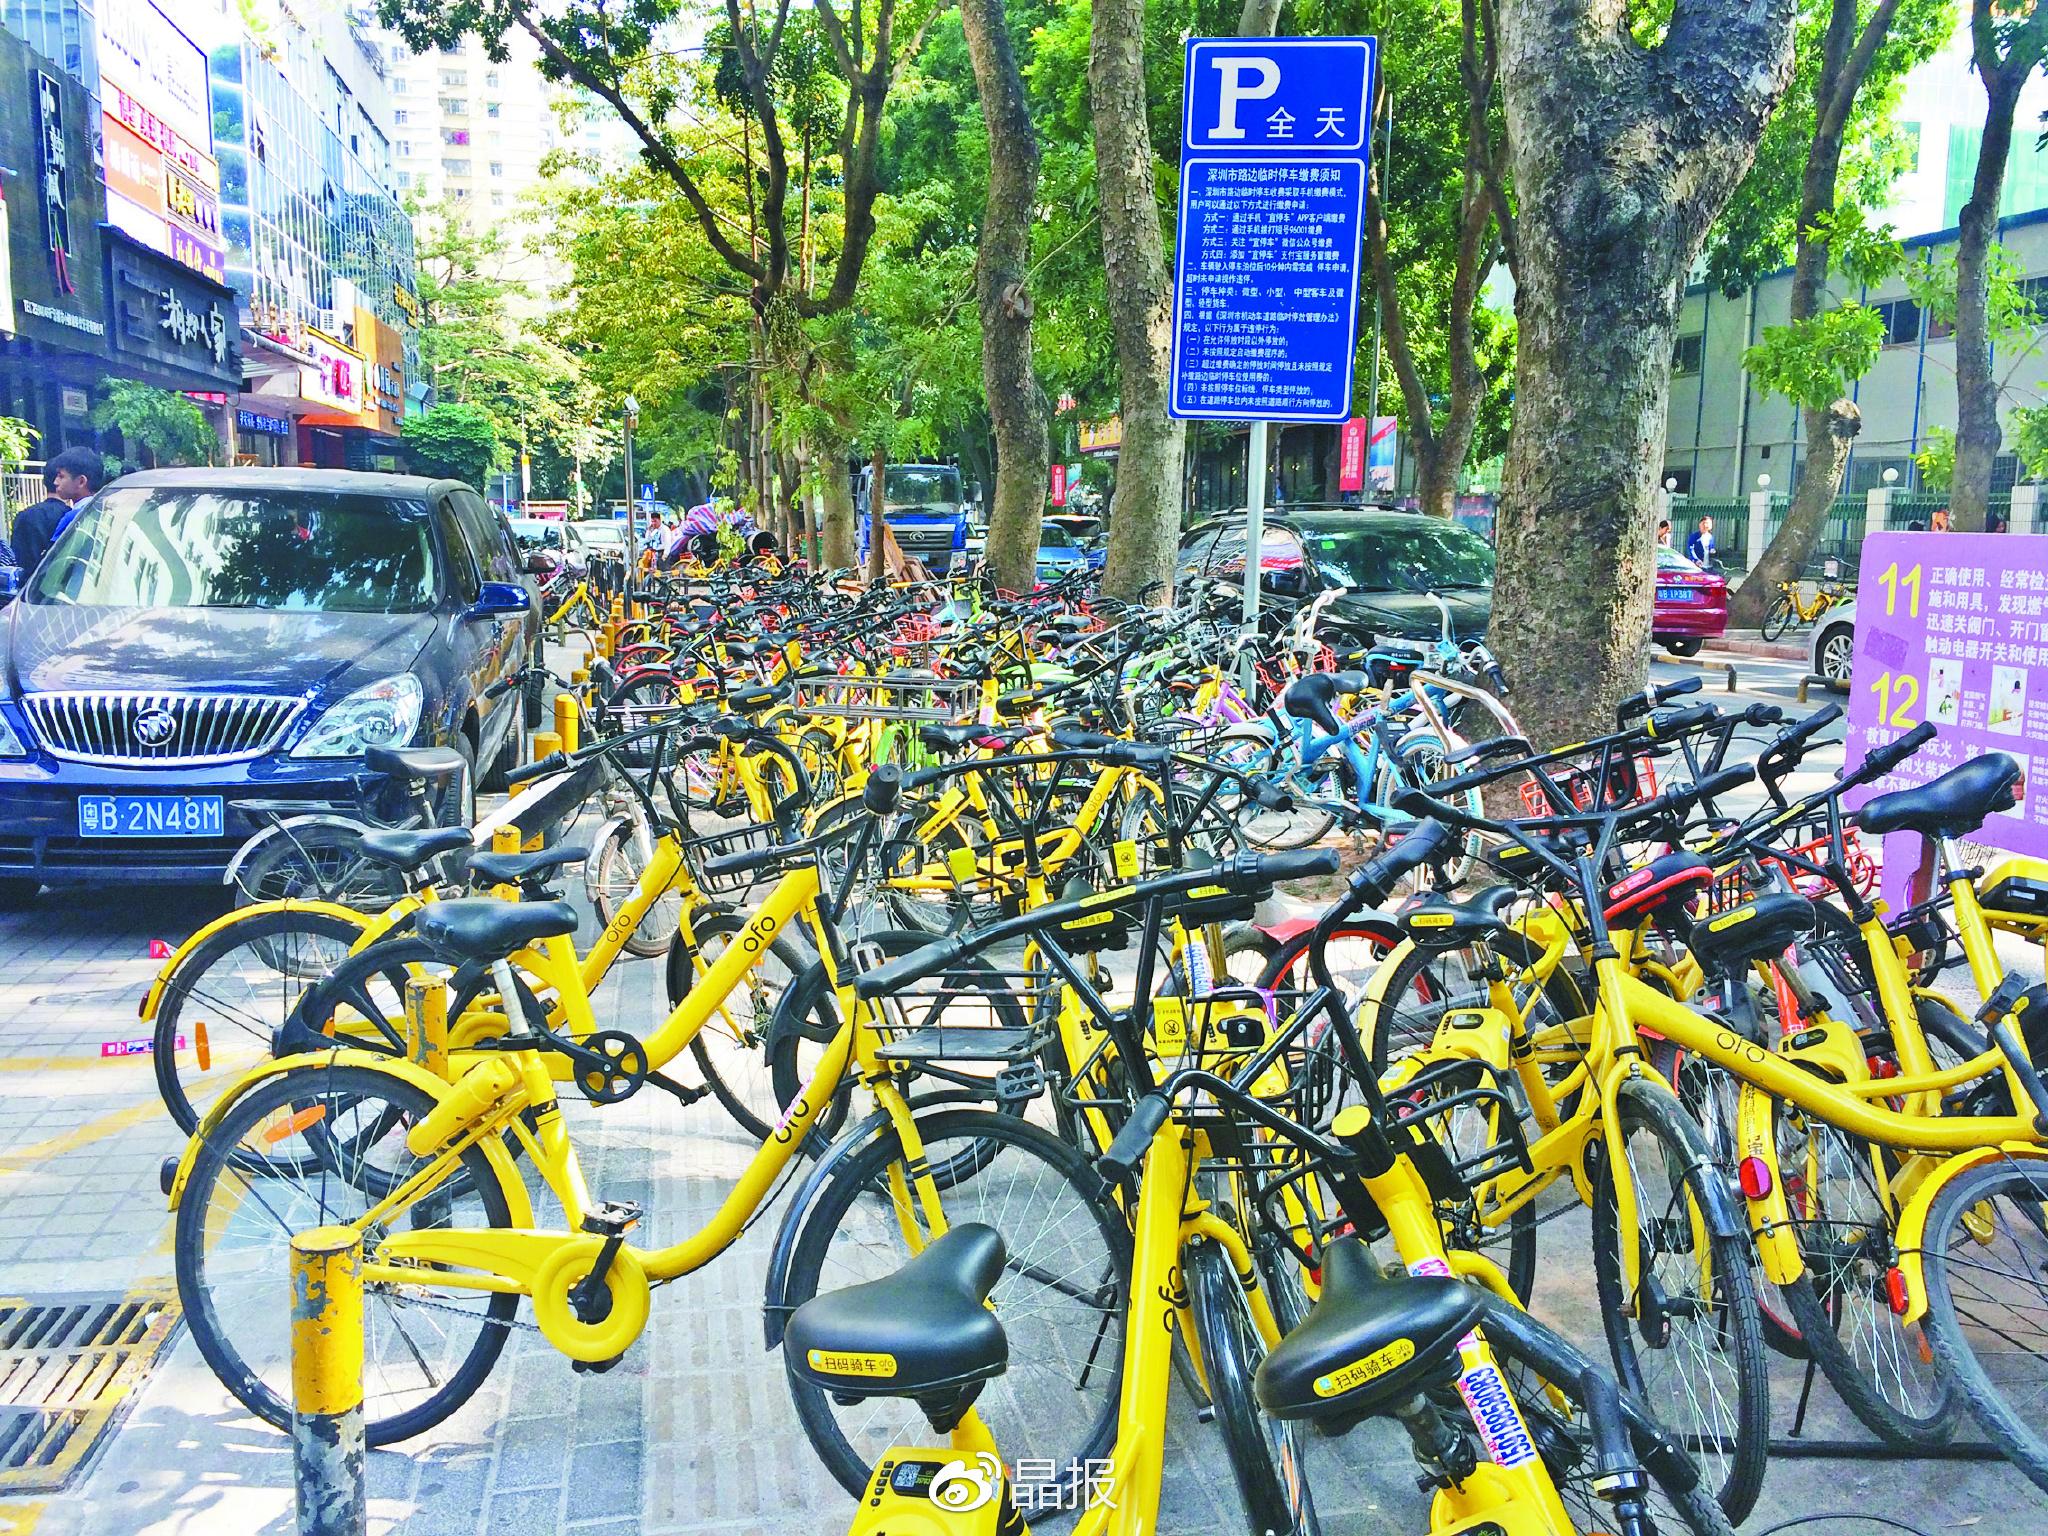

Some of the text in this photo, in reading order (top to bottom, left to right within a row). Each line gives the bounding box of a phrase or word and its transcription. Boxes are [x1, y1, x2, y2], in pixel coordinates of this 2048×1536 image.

[1208, 57, 1281, 139] P
[1207, 167, 1341, 183] 深圳市路边临时停车缴费须知
[1878, 562, 1922, 618] 11
[1930, 567, 2048, 591] 正确使用、经常检
[1871, 671, 1920, 729] 12
[83, 801, 221, 831] 粤B·2N48M
[606, 914, 631, 943] ofo
[743, 915, 776, 953] ofo
[1717, 1032, 1765, 1063] ofo
[825, 1357, 877, 1372] 扫码骑车
[1336, 1351, 1395, 1389] 扫码骑车
